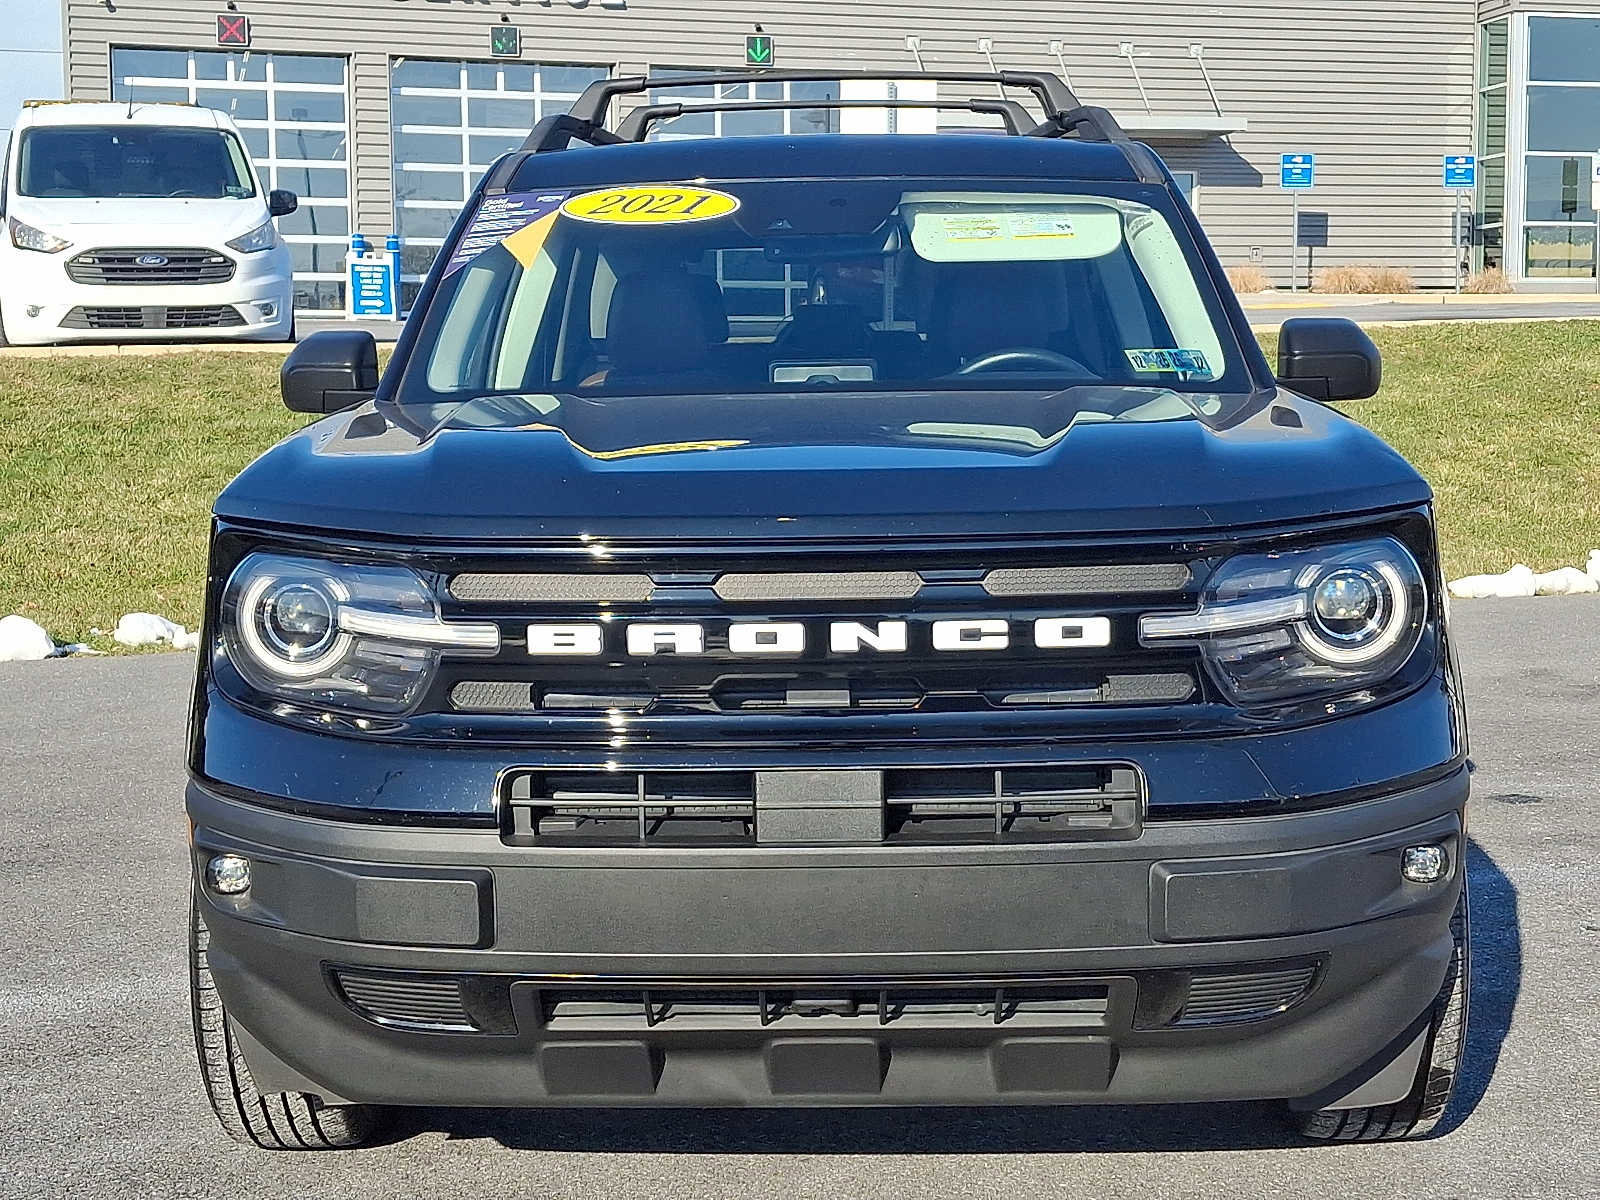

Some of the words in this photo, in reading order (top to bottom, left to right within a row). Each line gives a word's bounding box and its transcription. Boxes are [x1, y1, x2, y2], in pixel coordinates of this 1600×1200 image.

[587, 194, 712, 214] 2021
[1131, 355, 1147, 369] 12
[526, 617, 1112, 656] BRONCO
